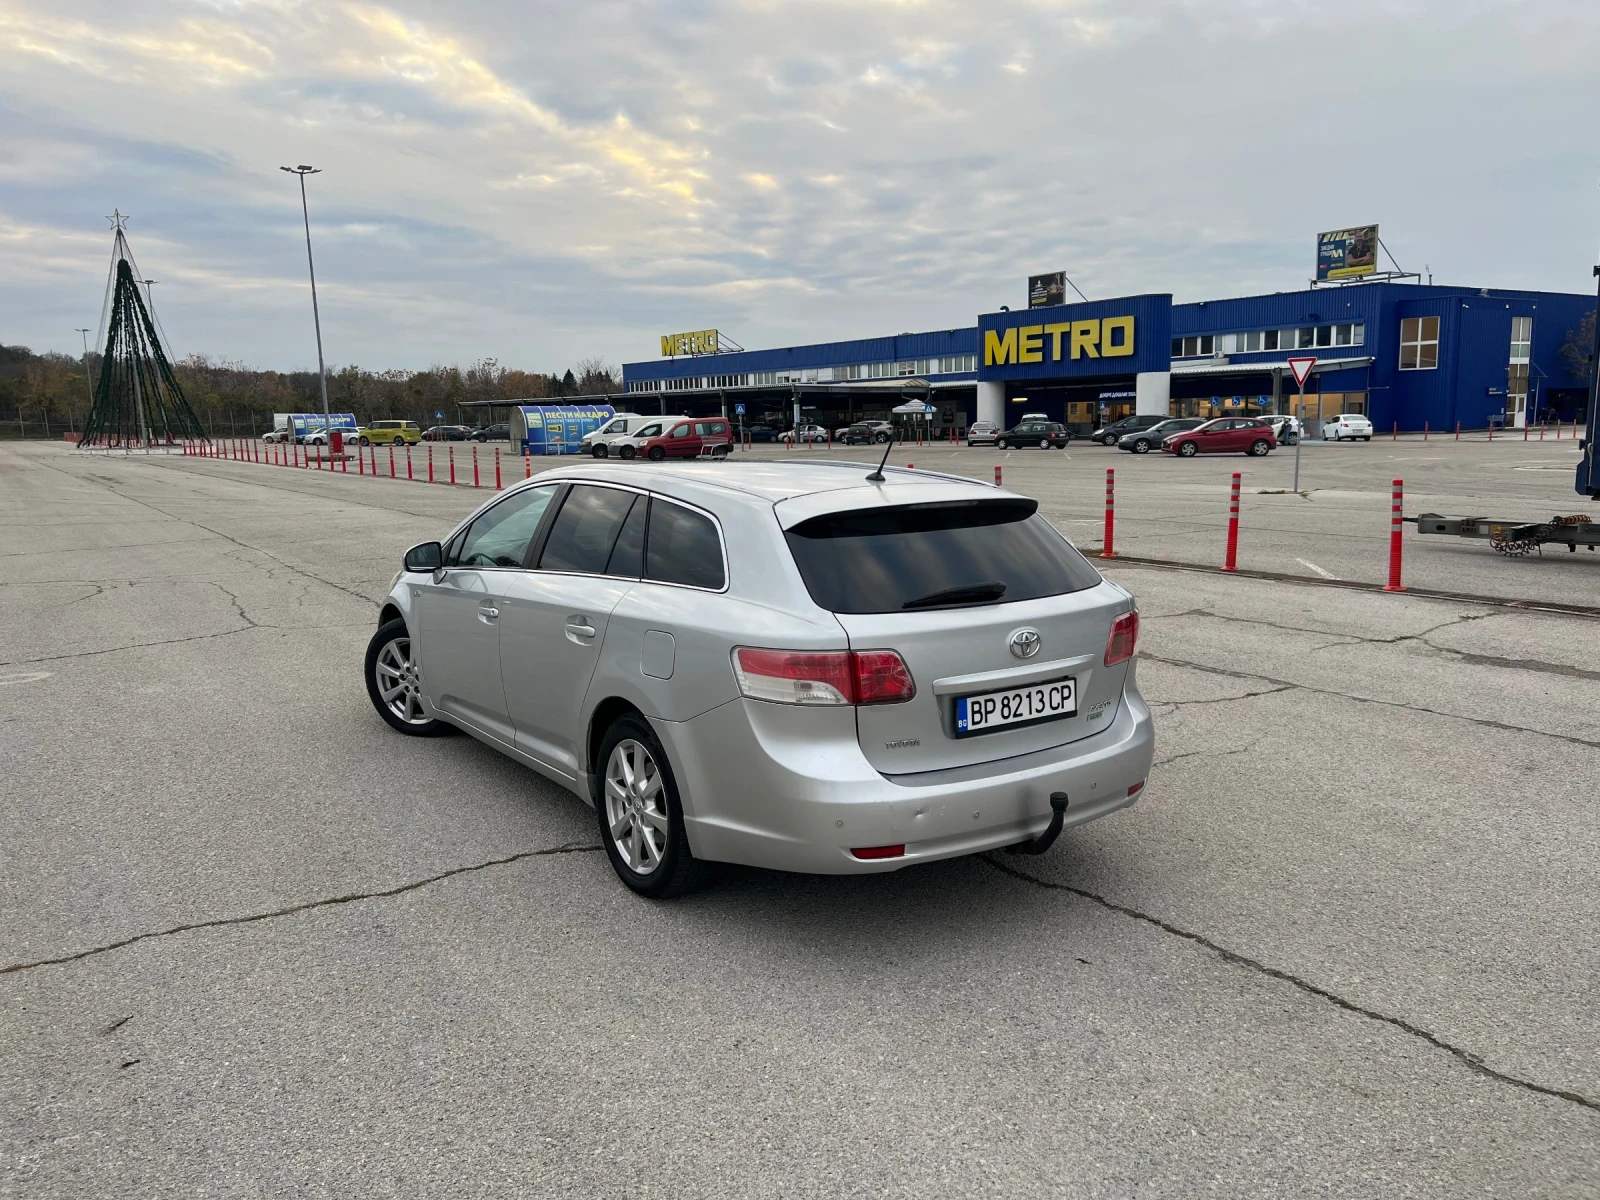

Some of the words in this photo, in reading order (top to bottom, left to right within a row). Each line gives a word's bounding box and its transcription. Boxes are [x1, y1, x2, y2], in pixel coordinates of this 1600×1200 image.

[661, 329, 718, 356] METRO
[985, 315, 1134, 366] METRO
[588, 411, 609, 419] ЕДРО
[970, 698, 996, 727] BP
[1000, 689, 1046, 720] 8213
[1049, 684, 1072, 711] CP
[958, 719, 967, 728] BG
[885, 738, 920, 750] TOYOTA
